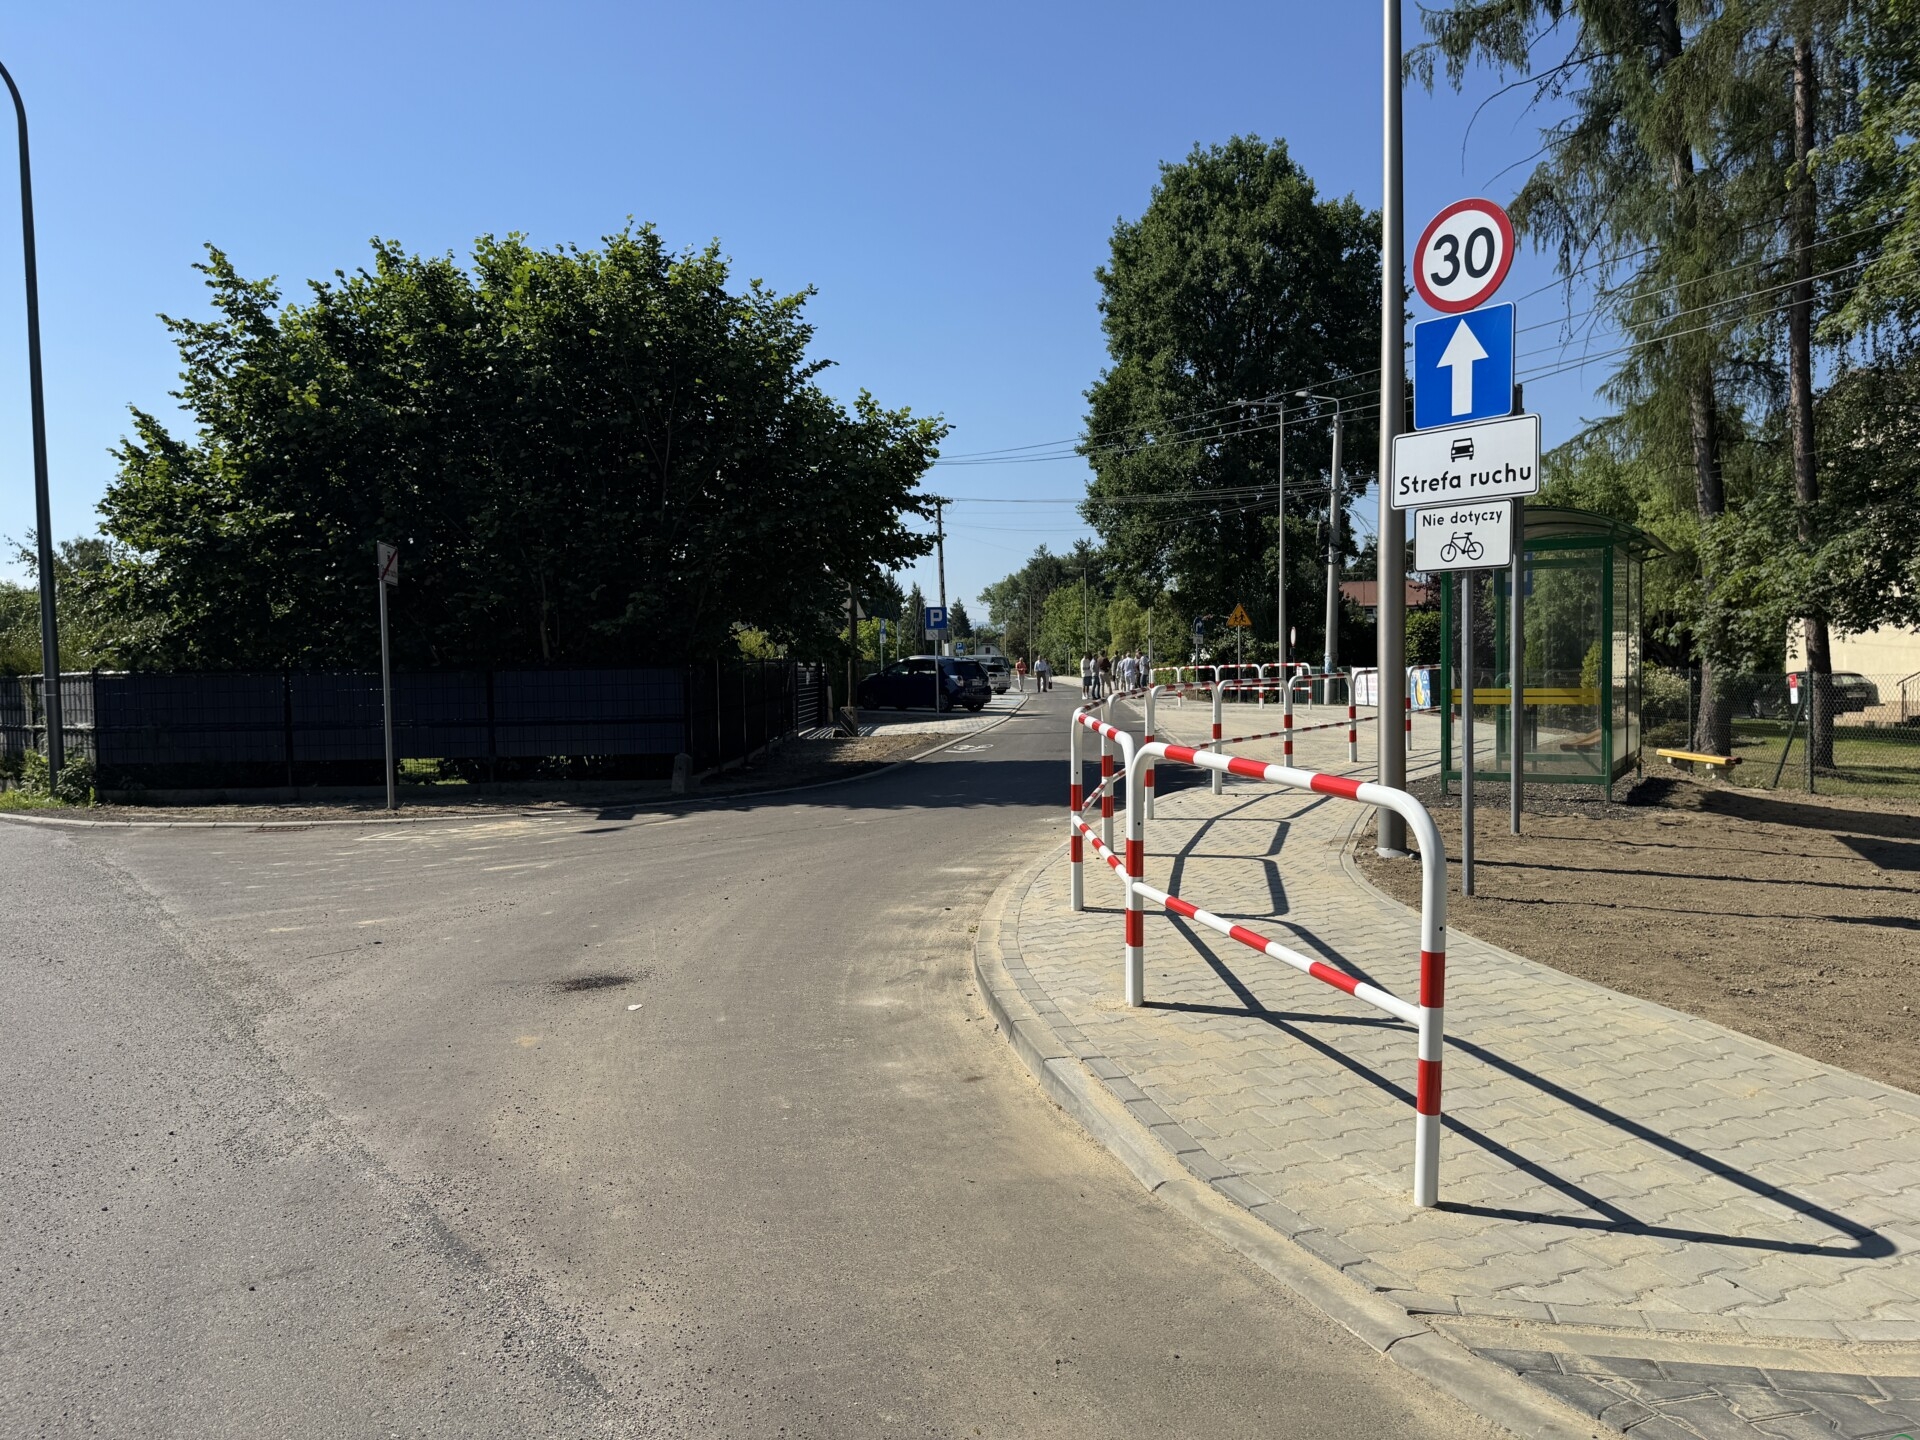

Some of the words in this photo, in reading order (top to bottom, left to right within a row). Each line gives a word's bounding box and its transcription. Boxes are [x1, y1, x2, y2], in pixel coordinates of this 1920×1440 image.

[1430, 227, 1495, 287] 30
[1399, 470, 1462, 495] Strefa
[1469, 462, 1532, 488] ruchu
[1422, 511, 1445, 528] Nie
[1450, 508, 1503, 526] dotyczy
[930, 609, 943, 627] P
